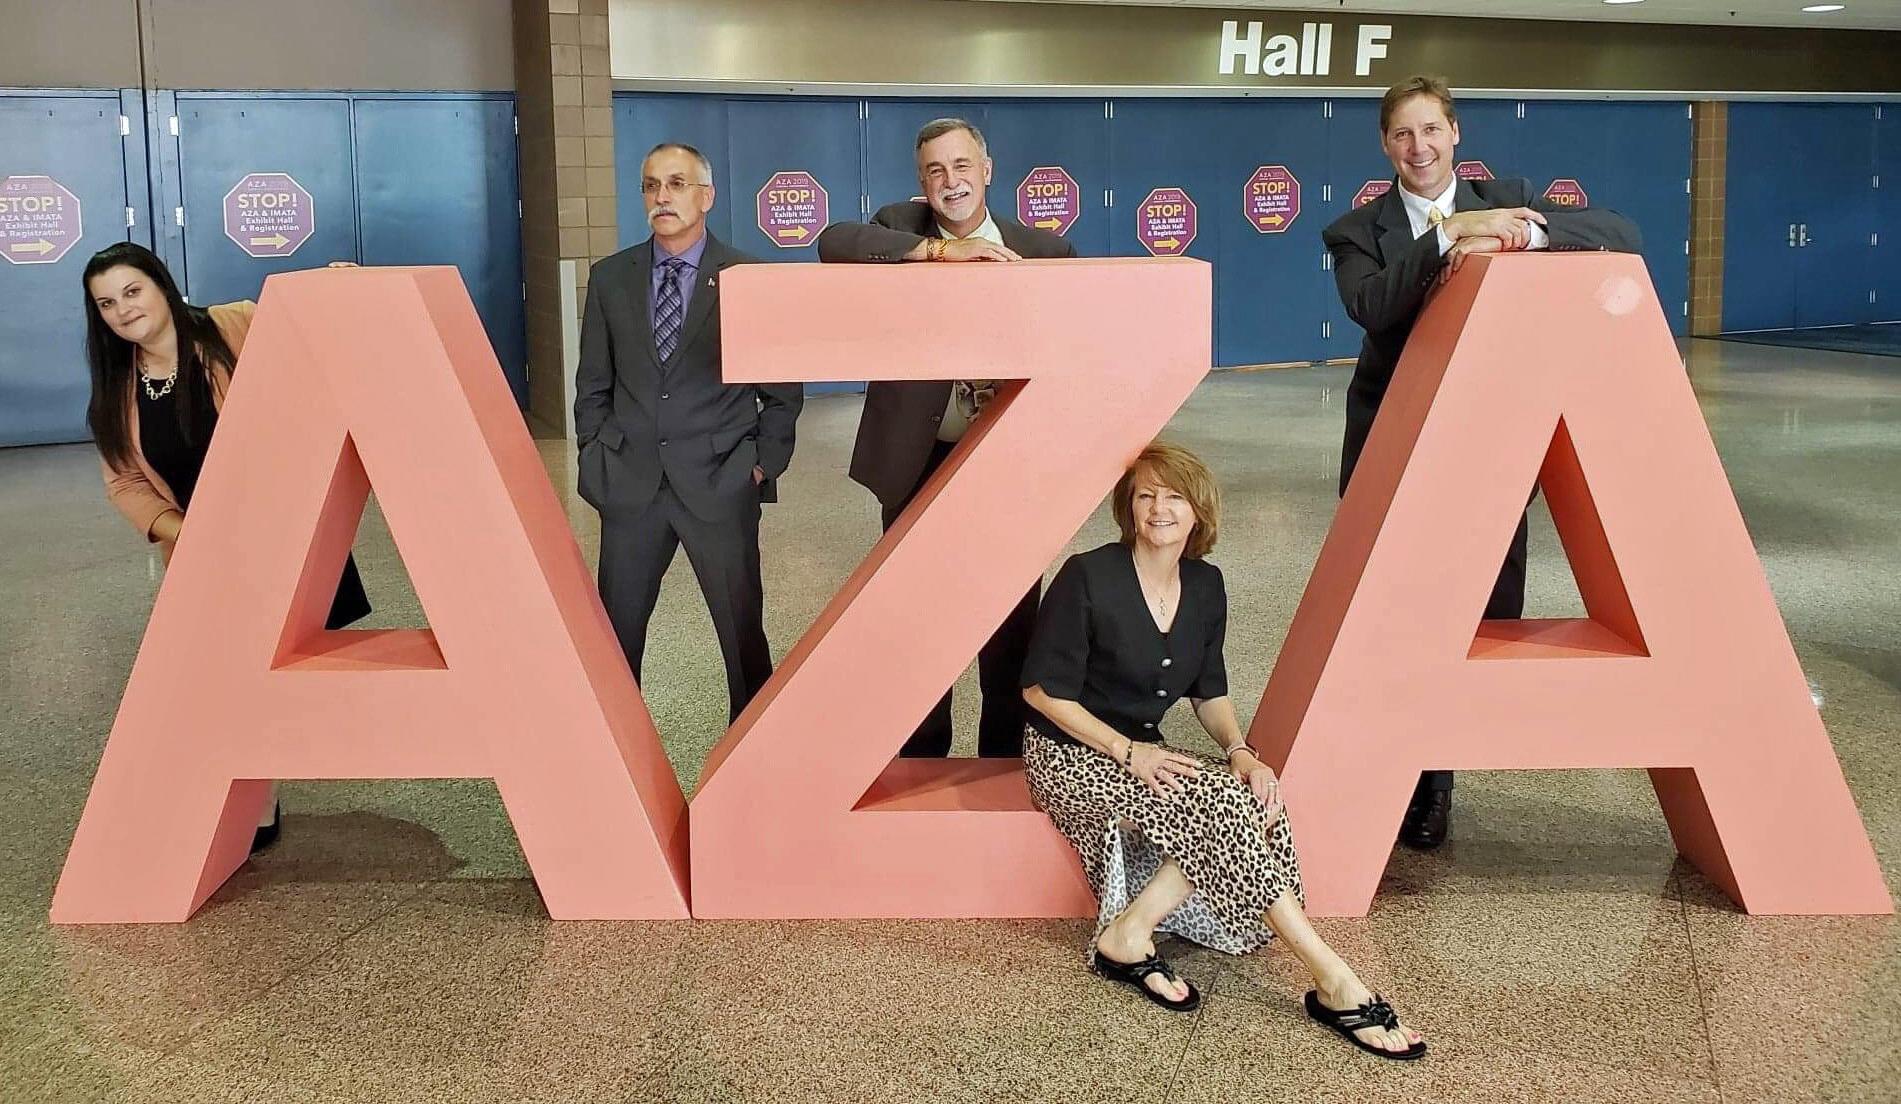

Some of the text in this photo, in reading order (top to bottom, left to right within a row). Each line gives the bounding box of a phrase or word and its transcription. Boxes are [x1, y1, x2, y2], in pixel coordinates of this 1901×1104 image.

[1219, 20, 1392, 76] Hall F
[1027, 184, 1068, 198] STOP!
[1253, 182, 1290, 194] STOP!
[0, 196, 62, 212] STOP!
[238, 193, 297, 208] STOP!
[768, 190, 816, 204] STOP!
[1147, 204, 1186, 218] STOP!
[10, 230, 65, 238] Registration
[250, 224, 299, 232] Registration
[50, 253, 1895, 925] AZA
